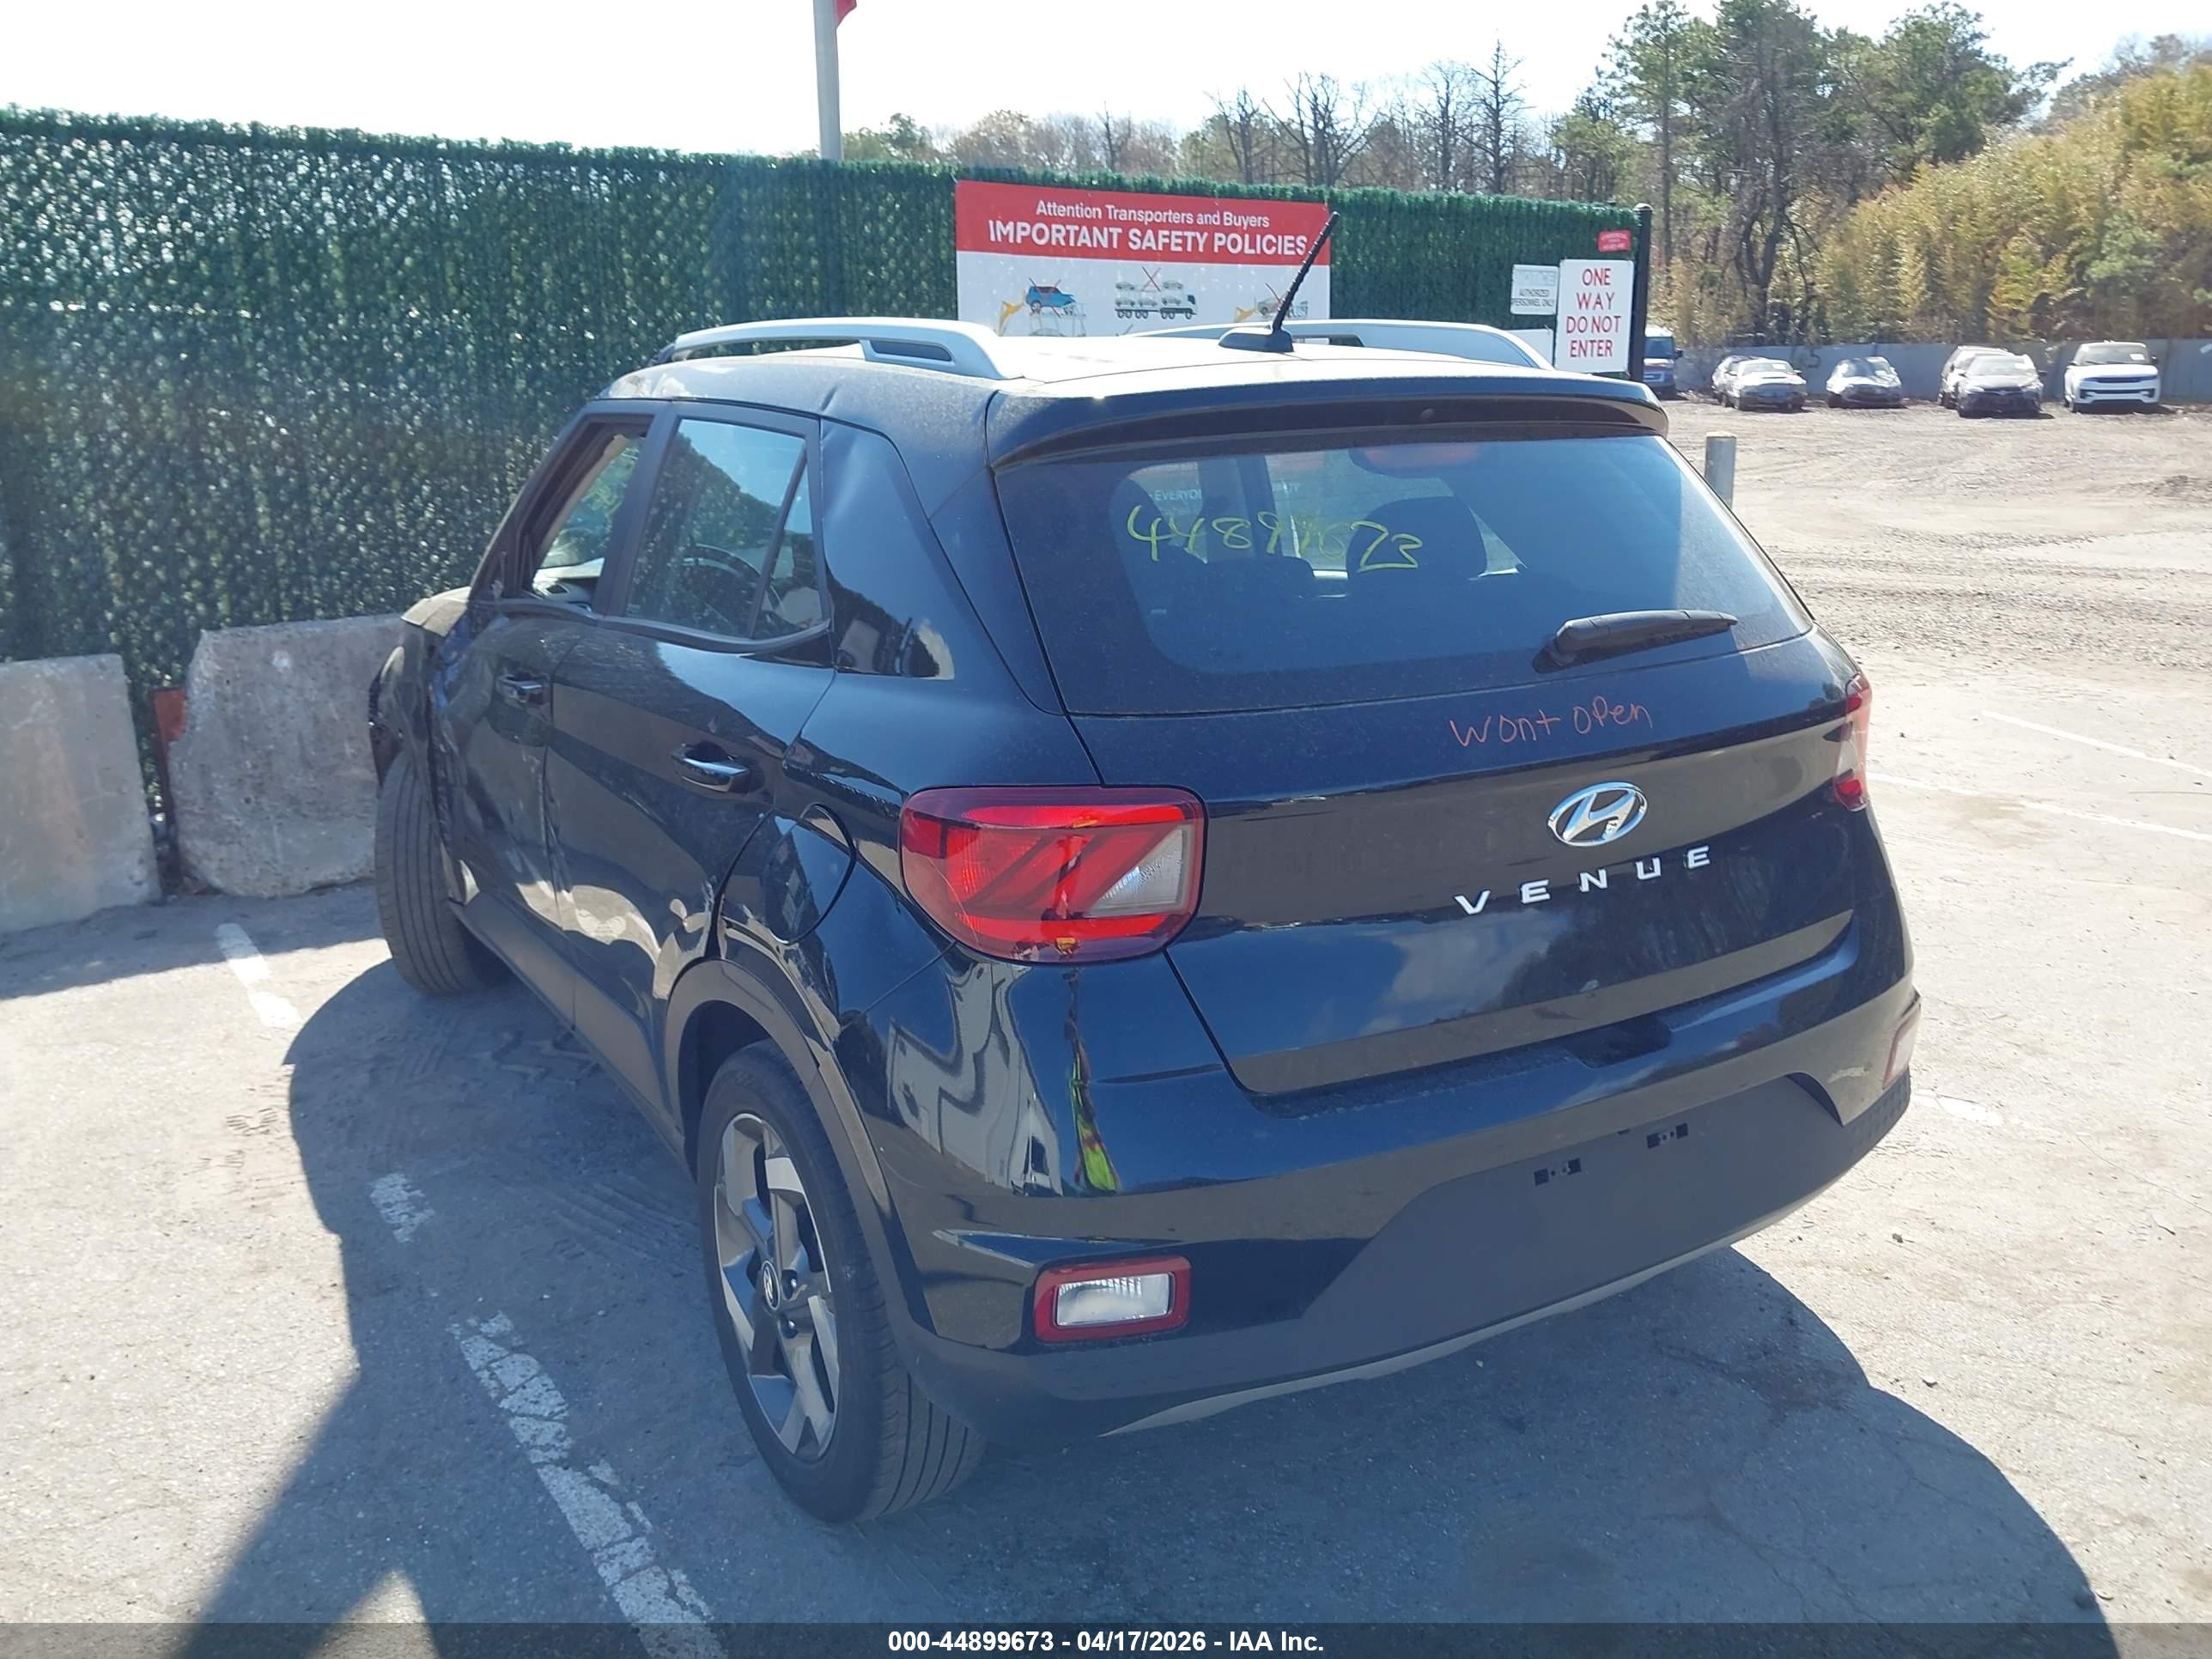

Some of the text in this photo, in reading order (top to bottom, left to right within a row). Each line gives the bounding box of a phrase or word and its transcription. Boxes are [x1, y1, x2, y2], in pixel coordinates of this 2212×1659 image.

[1036, 199, 1270, 230] Attention Transporters and Buyers
[988, 219, 1308, 256] IMPORTANT SAFETY POLICIES
[1582, 267, 1612, 286] ONE
[1576, 292, 1615, 310] WAY
[1565, 315, 1621, 333] DO NOT
[1570, 339, 1613, 357] ENTER
[1454, 845, 1711, 915] VENUE
